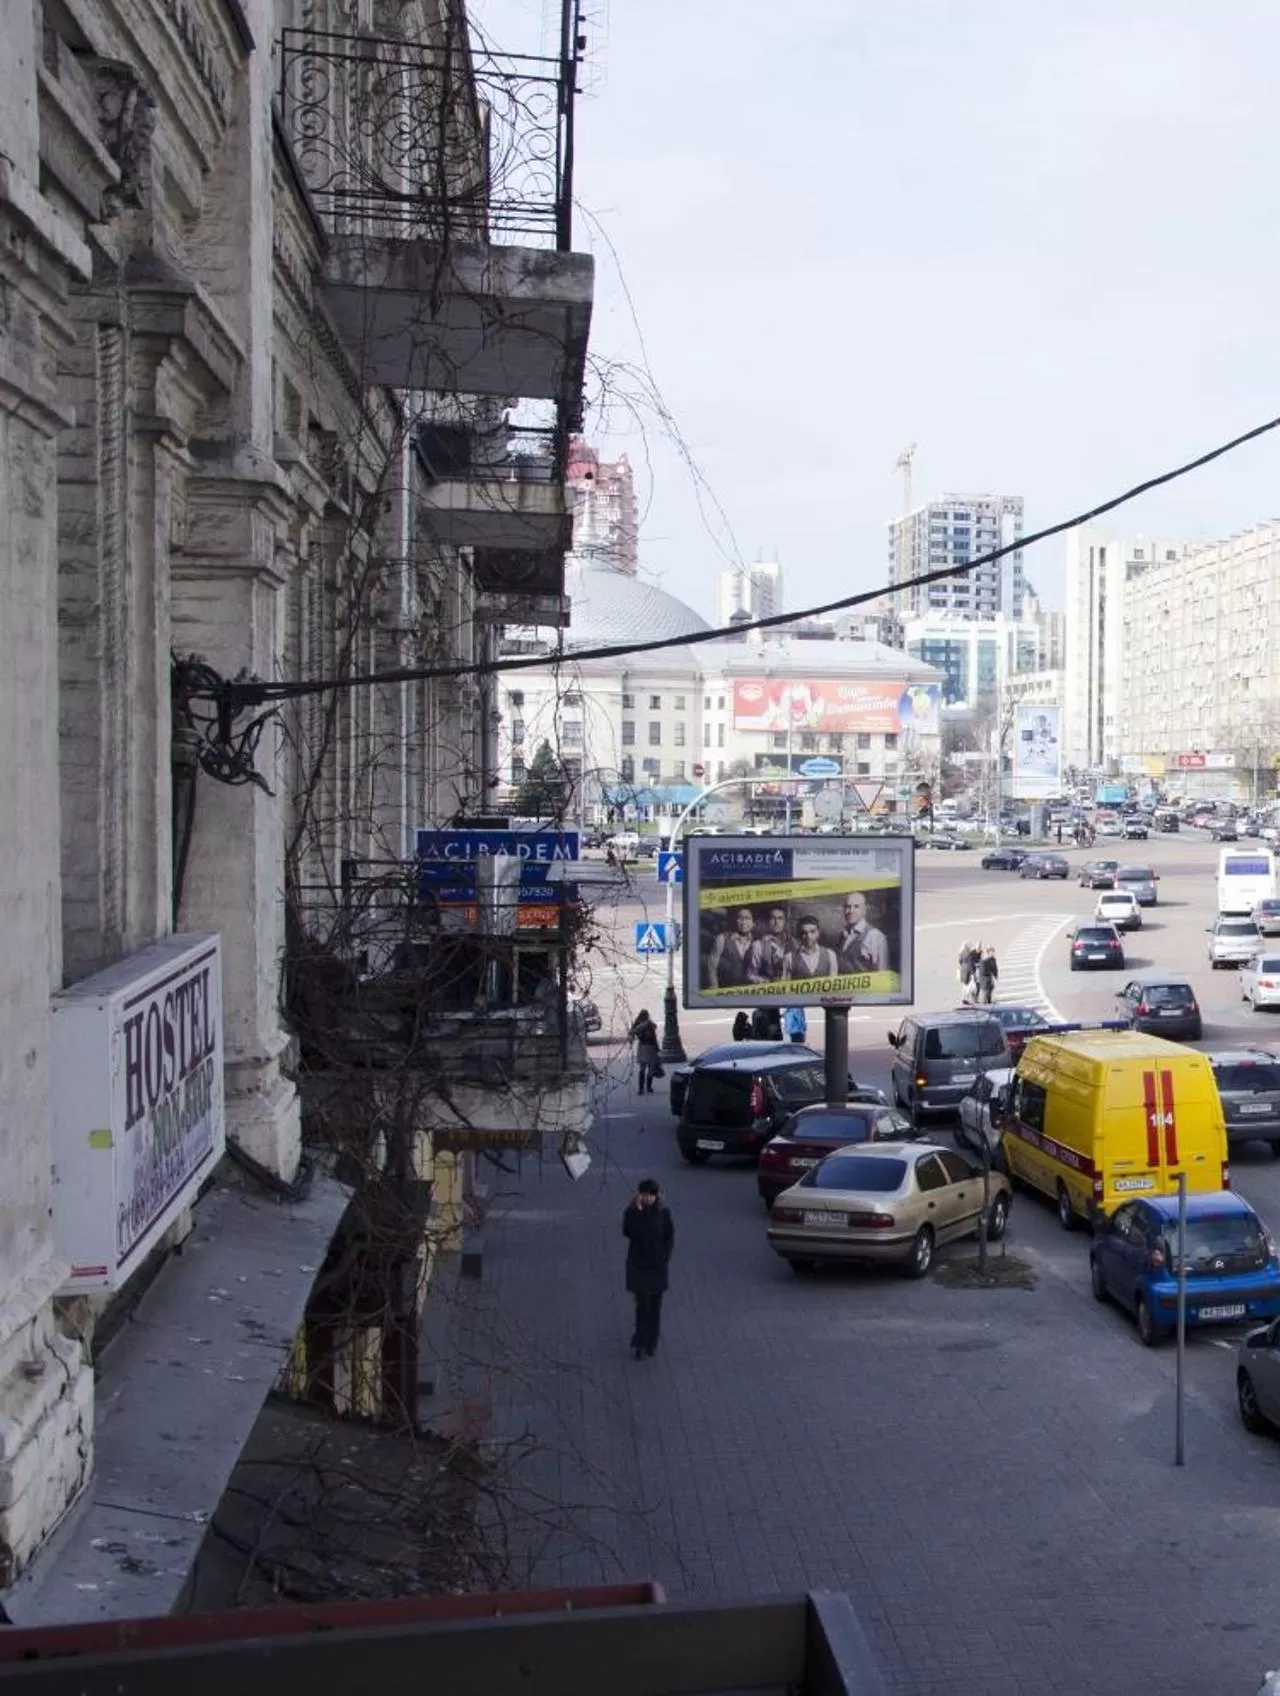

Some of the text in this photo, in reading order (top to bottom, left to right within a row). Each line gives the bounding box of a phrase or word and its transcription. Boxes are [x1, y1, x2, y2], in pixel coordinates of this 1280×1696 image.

[426, 842, 572, 861] ACIBADEM
[710, 851, 785, 865] ACIBADEM
[789, 975, 871, 995] ЧОЛОВІКІВ
[123, 967, 215, 1133] HOSTEL
